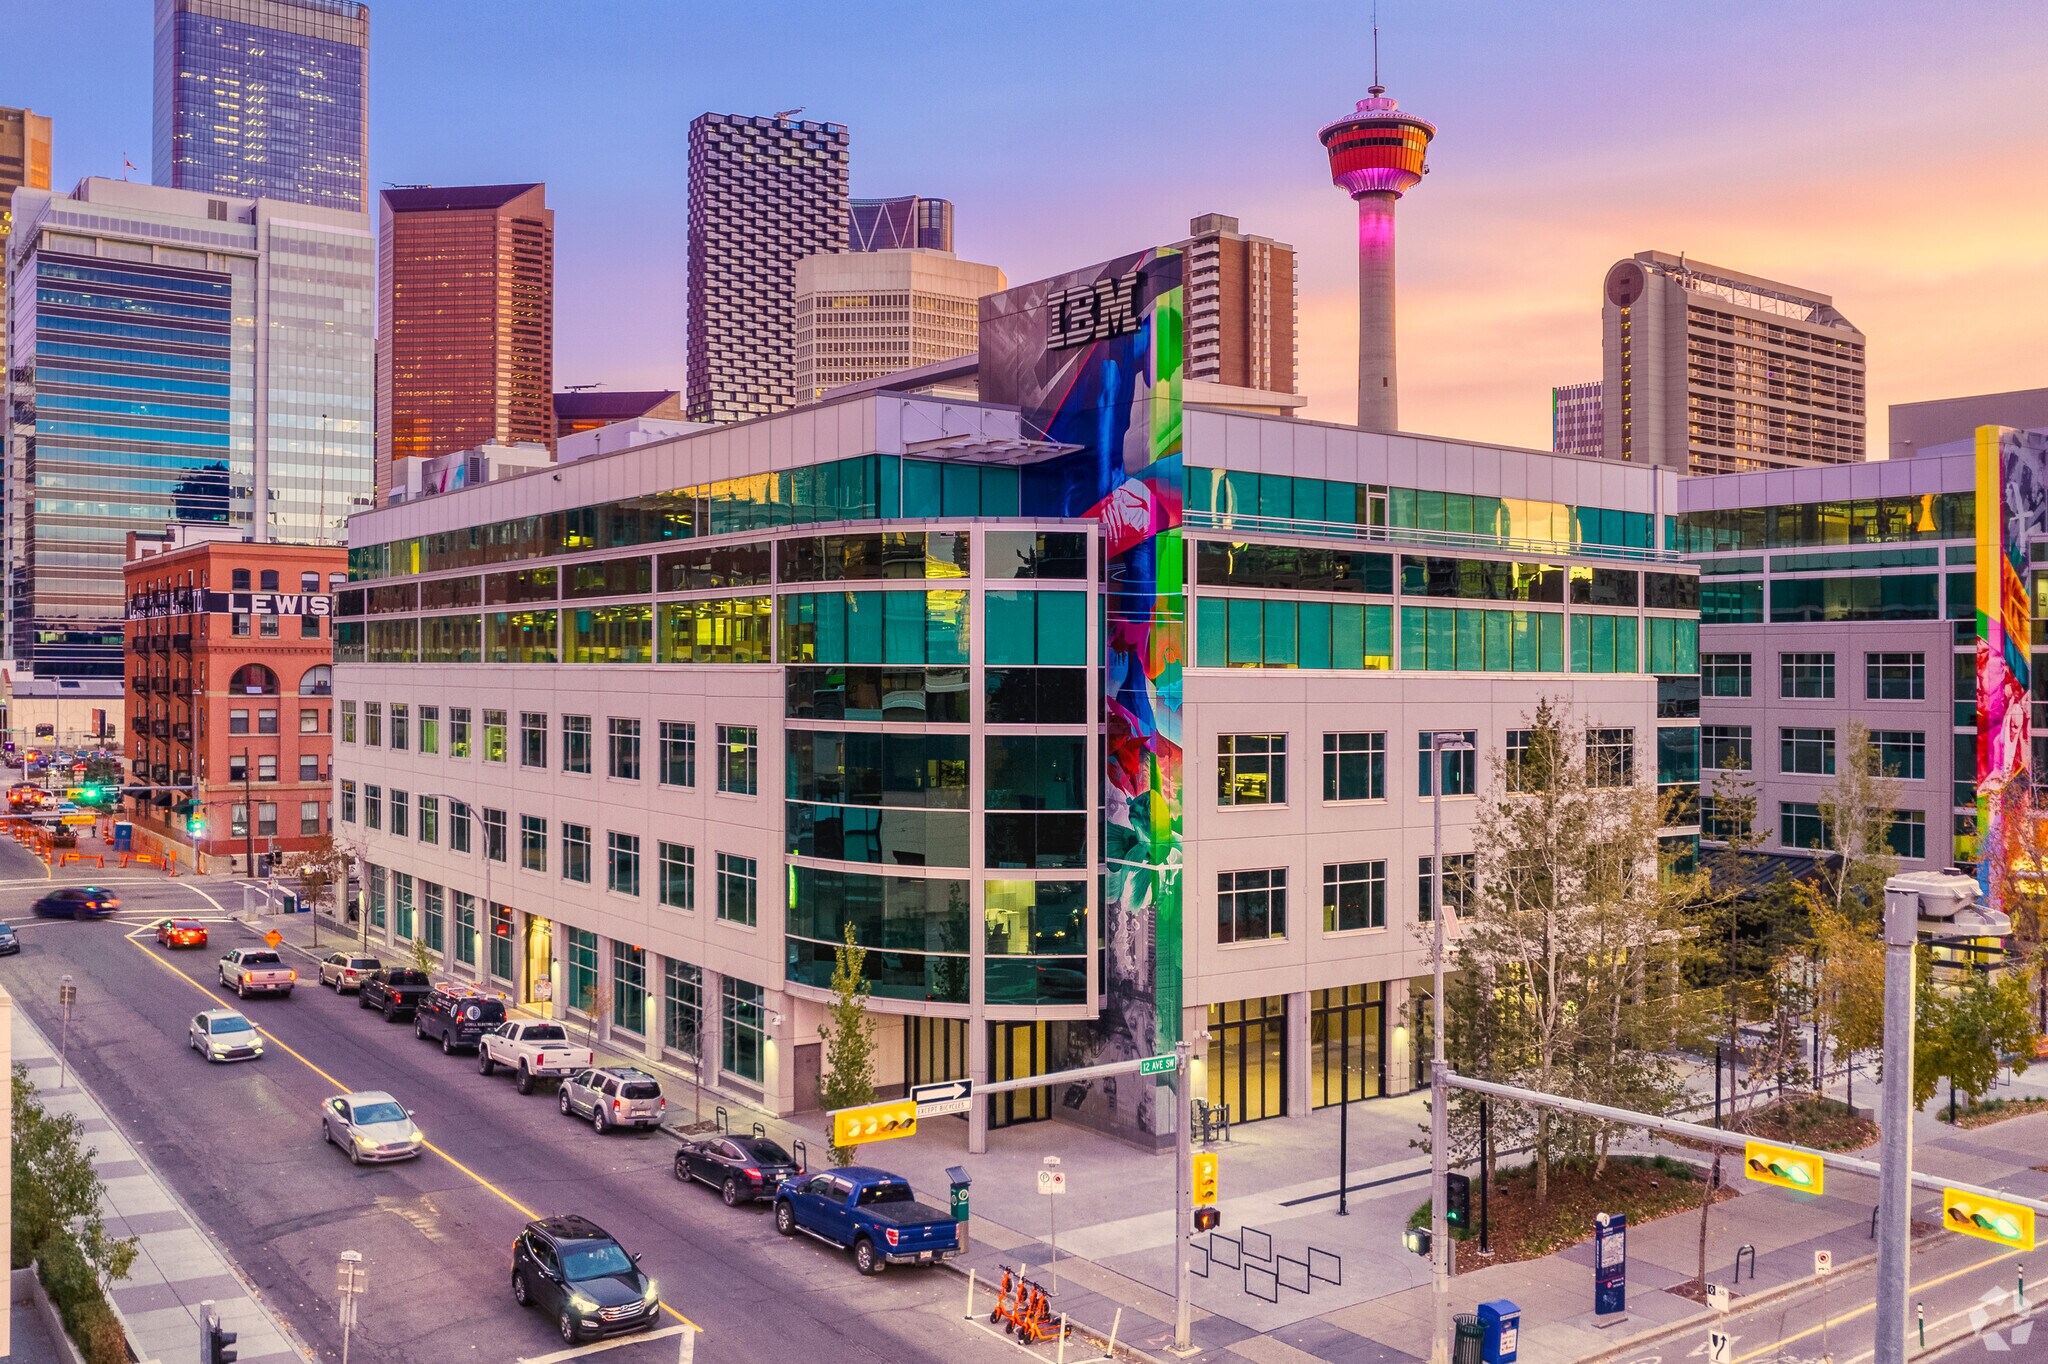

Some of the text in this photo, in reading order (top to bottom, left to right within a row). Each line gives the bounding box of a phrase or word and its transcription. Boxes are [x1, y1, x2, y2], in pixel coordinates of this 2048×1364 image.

[1047, 271, 1139, 350] IBM
[228, 594, 330, 615] LEWIS
[1143, 1058, 1175, 1072] 12 AVE SW
[917, 1102, 965, 1114] EXCEPT BICYCLES
